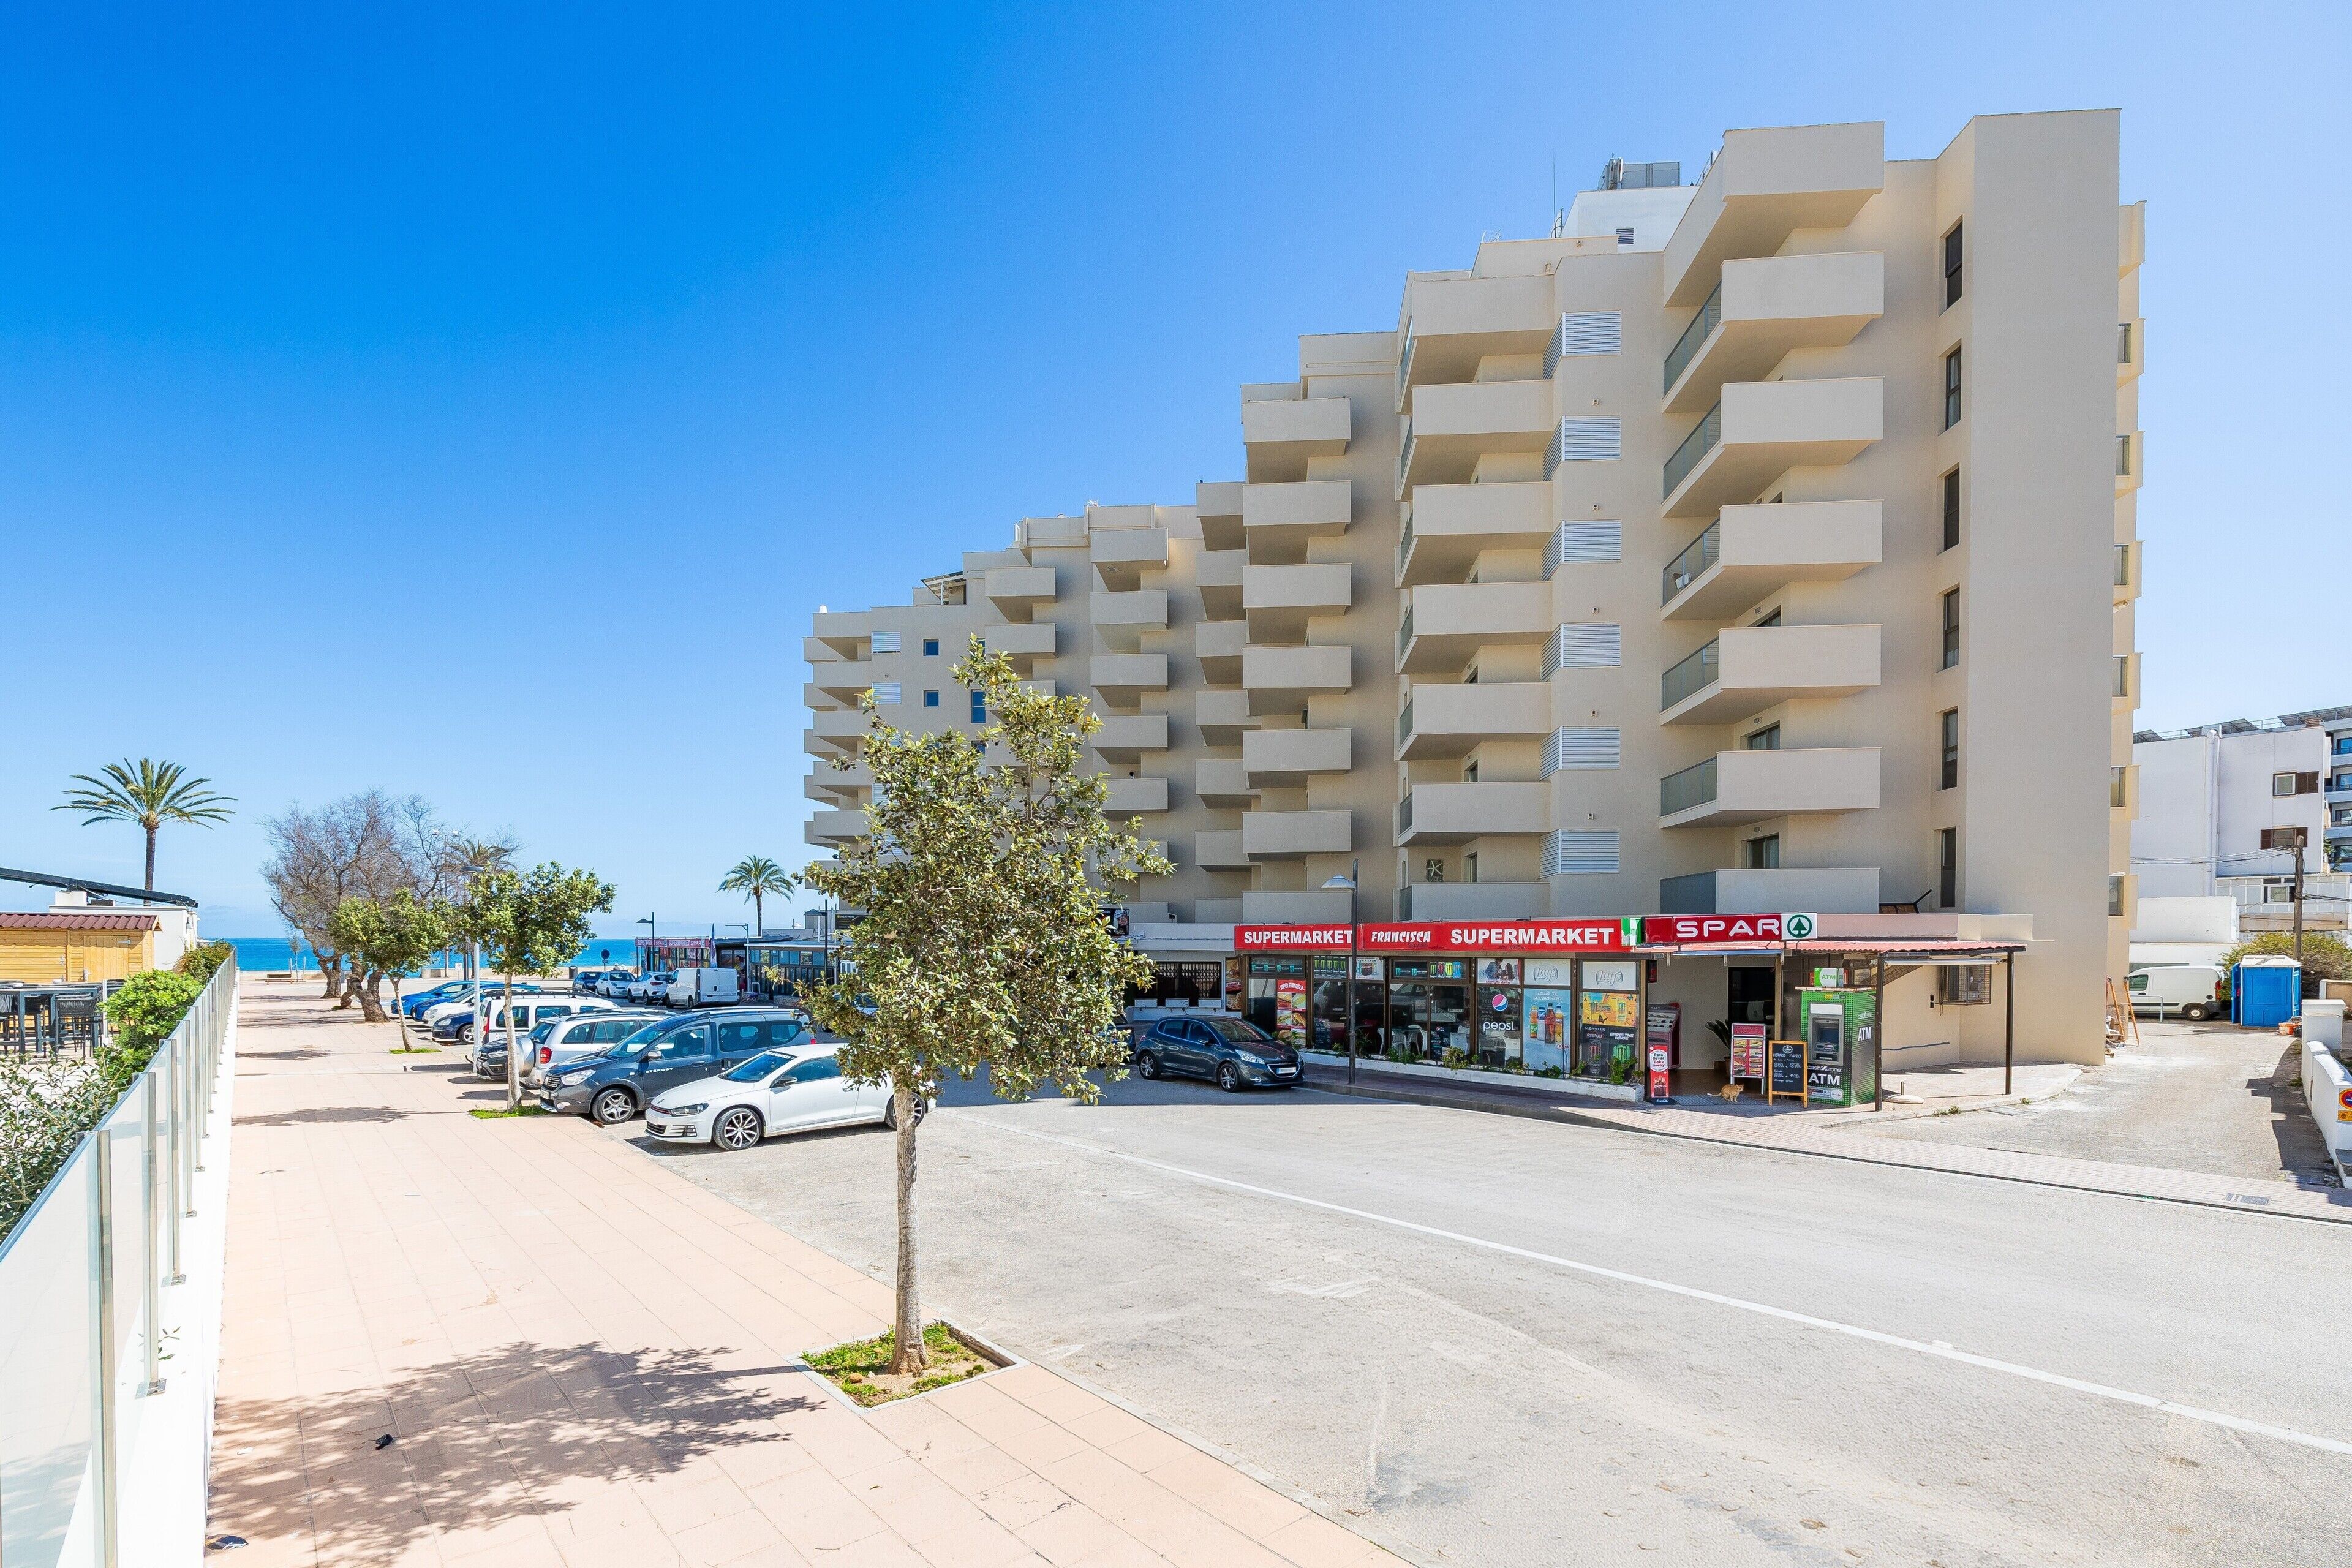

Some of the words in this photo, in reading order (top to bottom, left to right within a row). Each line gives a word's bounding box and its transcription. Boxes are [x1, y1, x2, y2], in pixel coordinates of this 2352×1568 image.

[1244, 930, 1352, 944] SUPERMARKET
[1371, 930, 1431, 943] FRANCISCA
[1450, 927, 1614, 944] SUPERMARKET
[1676, 919, 1780, 938] SPAR
[1483, 1021, 1514, 1031] pepsi
[1858, 1026, 1871, 1041] ATM
[1808, 1073, 1840, 1085] ATM
